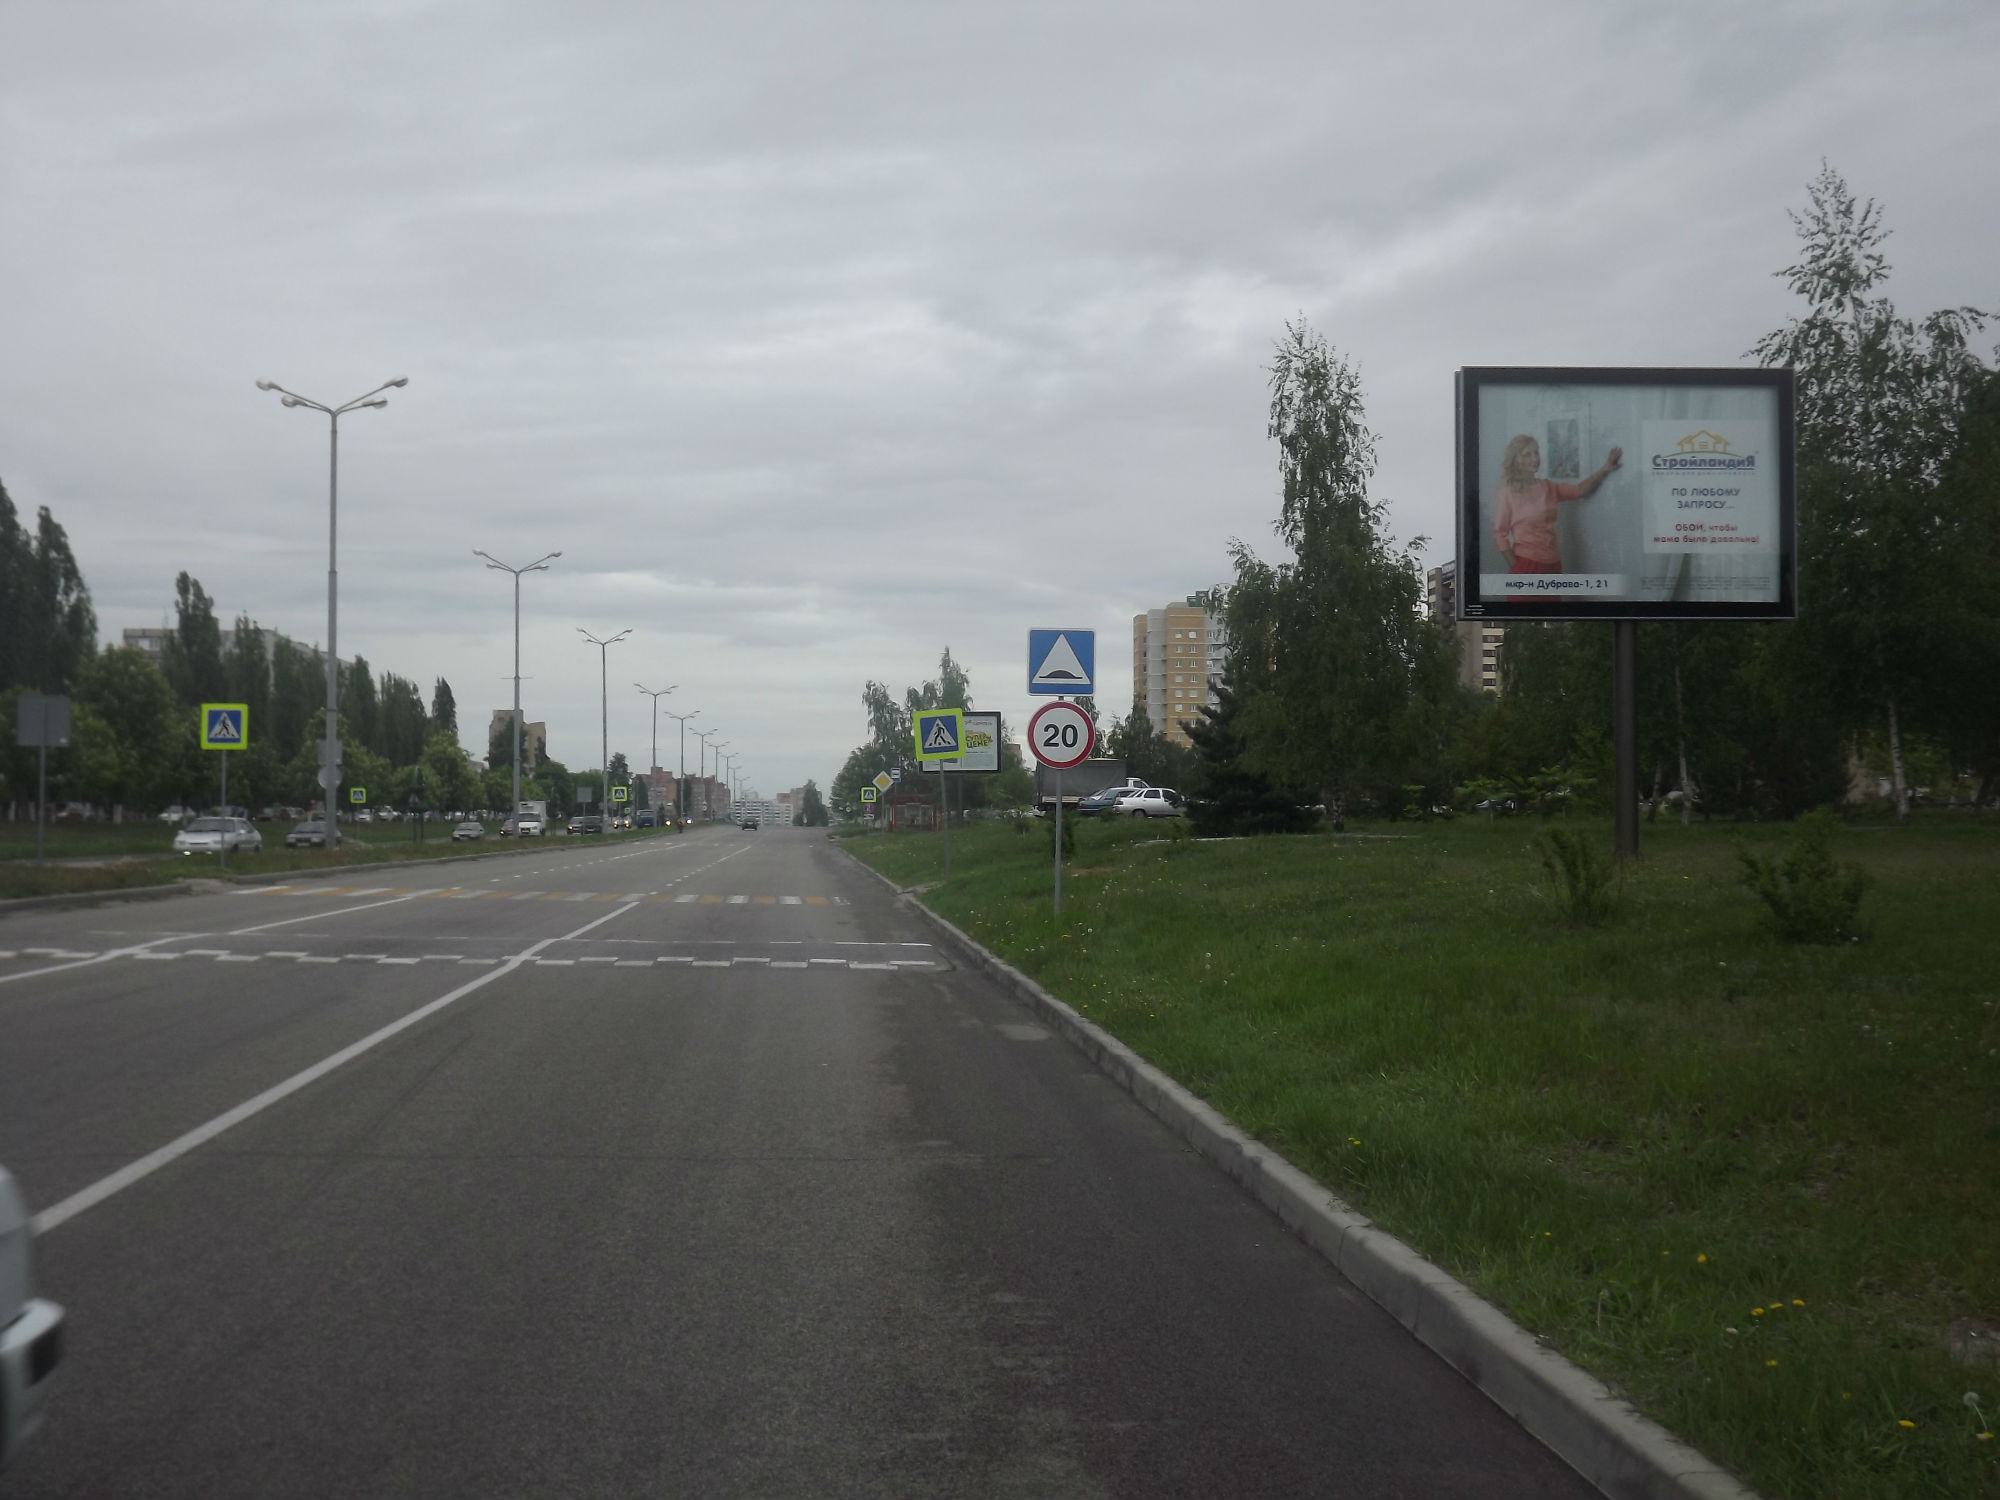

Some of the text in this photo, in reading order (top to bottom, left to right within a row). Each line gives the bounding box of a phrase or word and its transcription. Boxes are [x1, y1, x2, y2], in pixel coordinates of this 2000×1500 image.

[1672, 487, 1741, 497] ПО ЛЮБОМУ
[1675, 523, 1706, 533] ОБОИ,
[1043, 723, 1078, 748] 20
